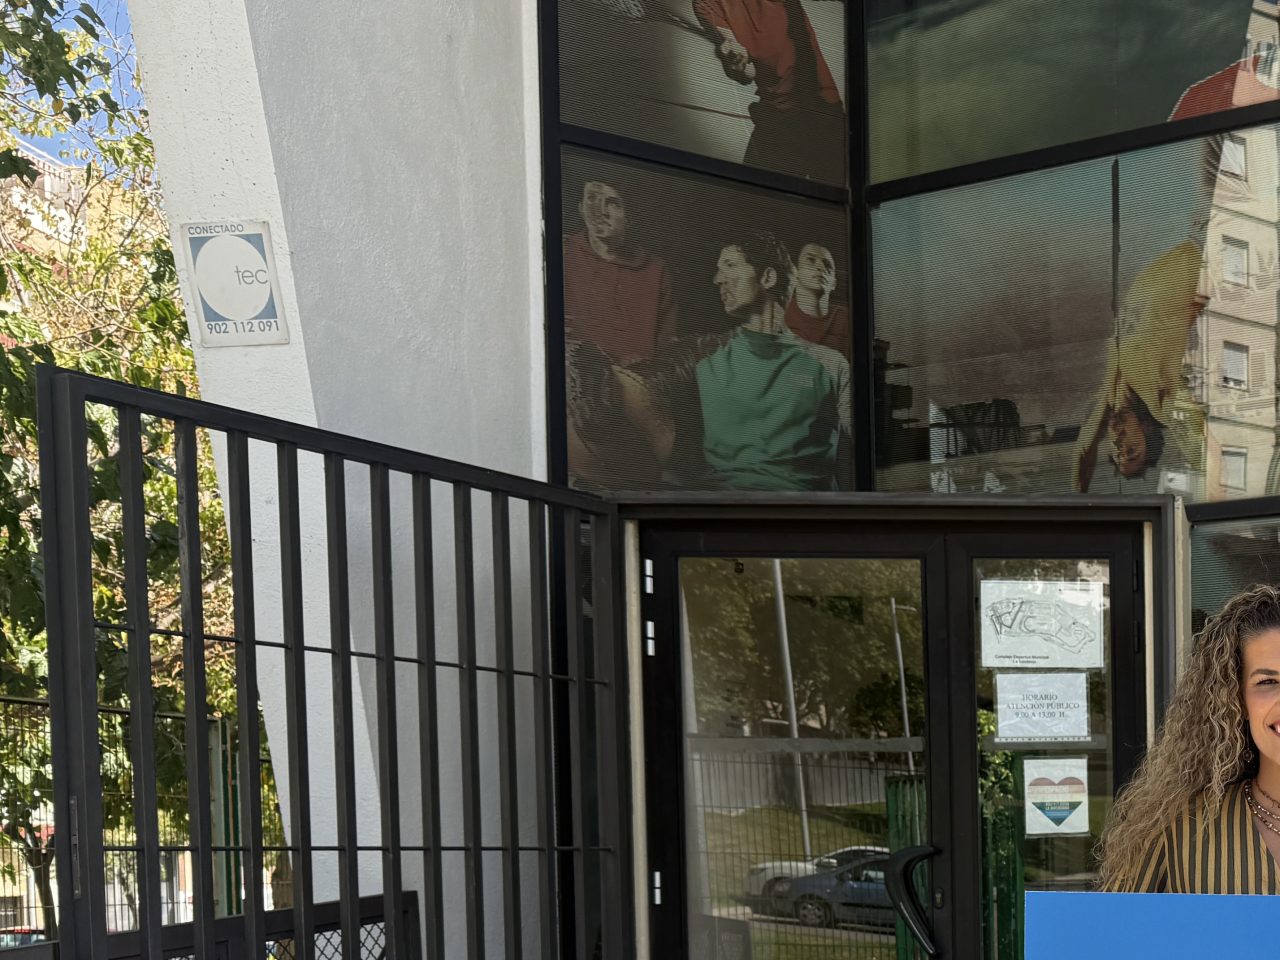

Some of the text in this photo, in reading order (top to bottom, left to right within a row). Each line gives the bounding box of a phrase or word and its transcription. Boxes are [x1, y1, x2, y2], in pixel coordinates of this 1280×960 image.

[188, 224, 244, 235] CONECTADO
[234, 265, 268, 285] tec
[207, 320, 280, 334] 902 112 091
[1007, 701, 1080, 710] ATENCIÓN PÚBLICO
